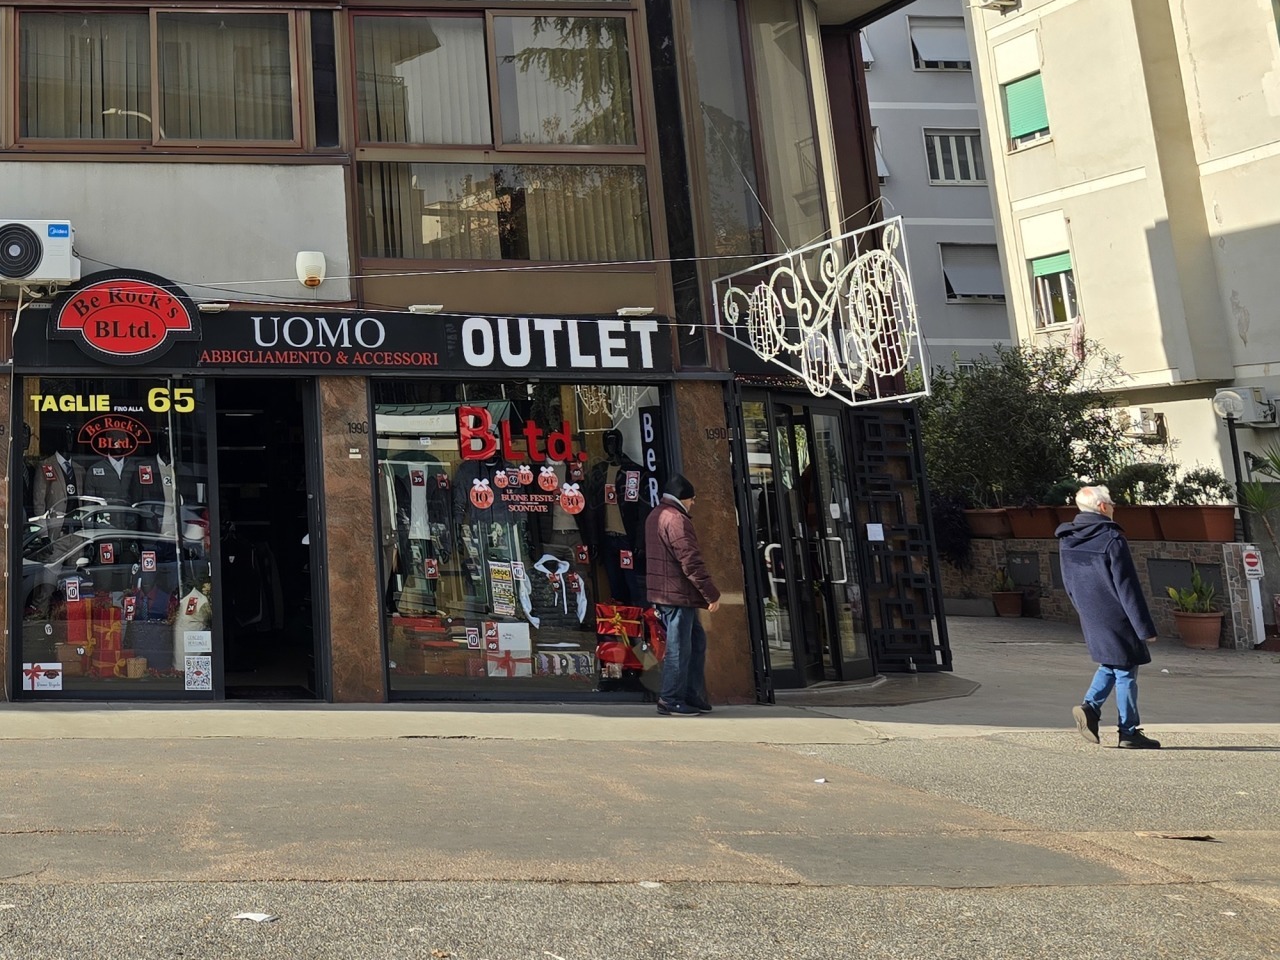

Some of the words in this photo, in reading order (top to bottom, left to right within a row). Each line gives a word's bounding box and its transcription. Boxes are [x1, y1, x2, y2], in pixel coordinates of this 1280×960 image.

[72, 296, 100, 318] Be
[108, 287, 179, 319] Rock's
[95, 320, 157, 339] BLtd.
[251, 316, 386, 349] UOMO
[462, 317, 659, 369] OUTLET
[199, 350, 332, 365] ABBIGLIAMENTO
[336, 351, 349, 364] &
[352, 351, 439, 366] ACCESSORI
[30, 394, 111, 412] TAGLIE
[148, 387, 195, 413] 65
[85, 422, 101, 437] Be
[104, 417, 143, 438] Rock's
[705, 427, 727, 440] 199D
[501, 494, 528, 502] BUONE
[530, 494, 554, 502] FESTE
[508, 504, 549, 513] SCONTATE
